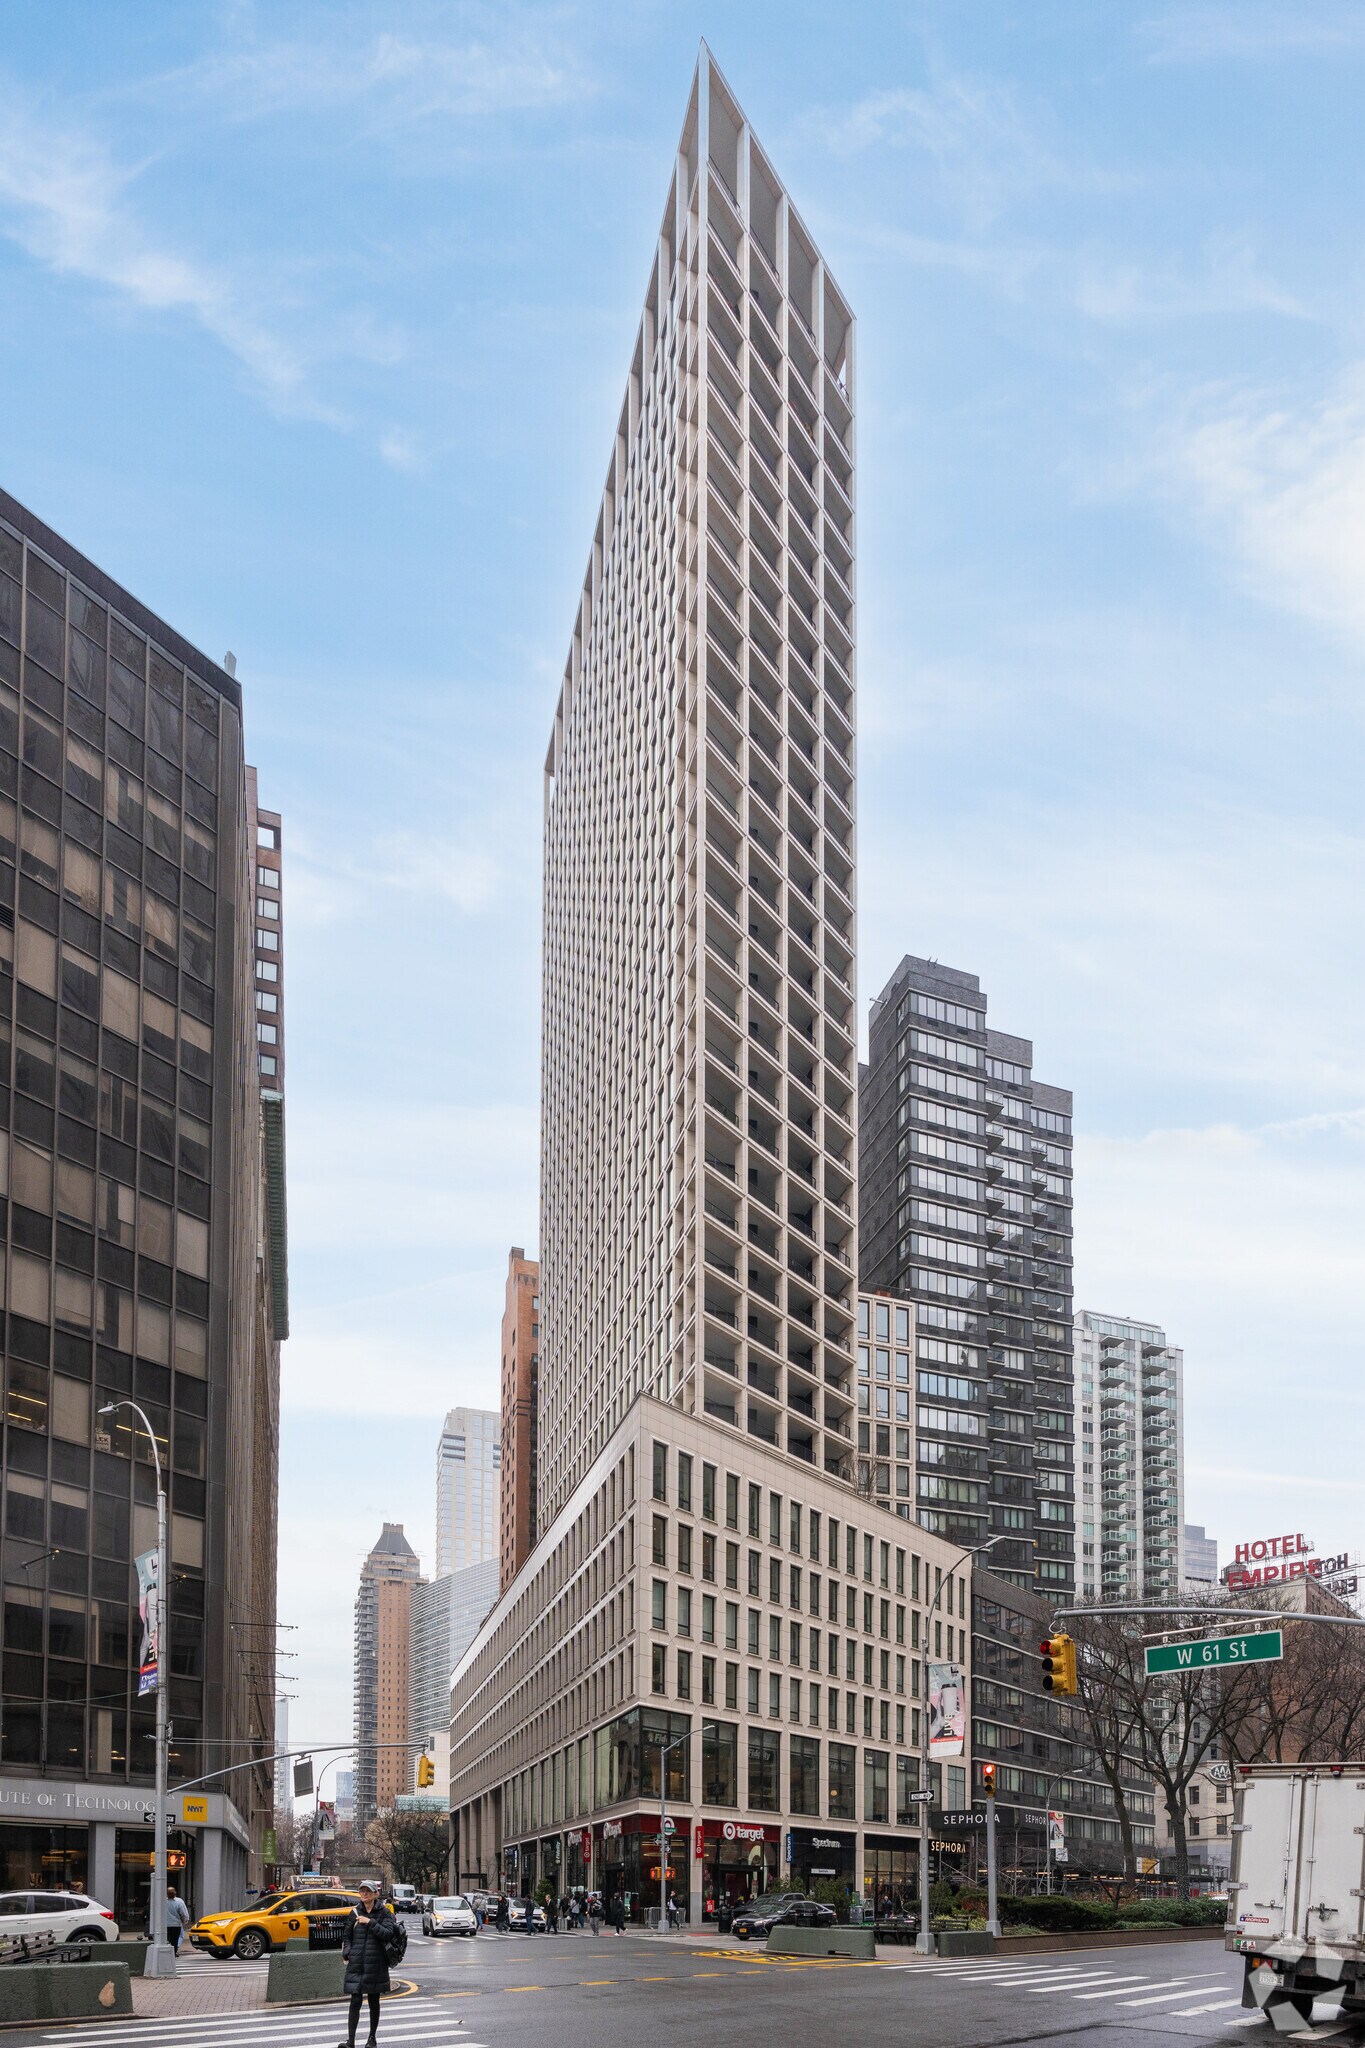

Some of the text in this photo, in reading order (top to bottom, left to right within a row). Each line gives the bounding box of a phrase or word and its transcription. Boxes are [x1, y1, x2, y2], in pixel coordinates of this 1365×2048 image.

[1235, 1533, 1309, 1564] HOTEL
[1228, 1558, 1321, 1592] EMPIRE
[1177, 1640, 1247, 1665] W 61 St
[1214, 1764, 1231, 1778] AAA
[37, 1793, 57, 1806] OF
[63, 1793, 156, 1812] TECHNOLOG
[944, 1813, 1001, 1825] SEPHOA
[1025, 1814, 1047, 1826] SEPHOR
[737, 1826, 765, 1842] target
[812, 1838, 841, 1849] Spectrum
[931, 1841, 966, 1853] SEPHORA
